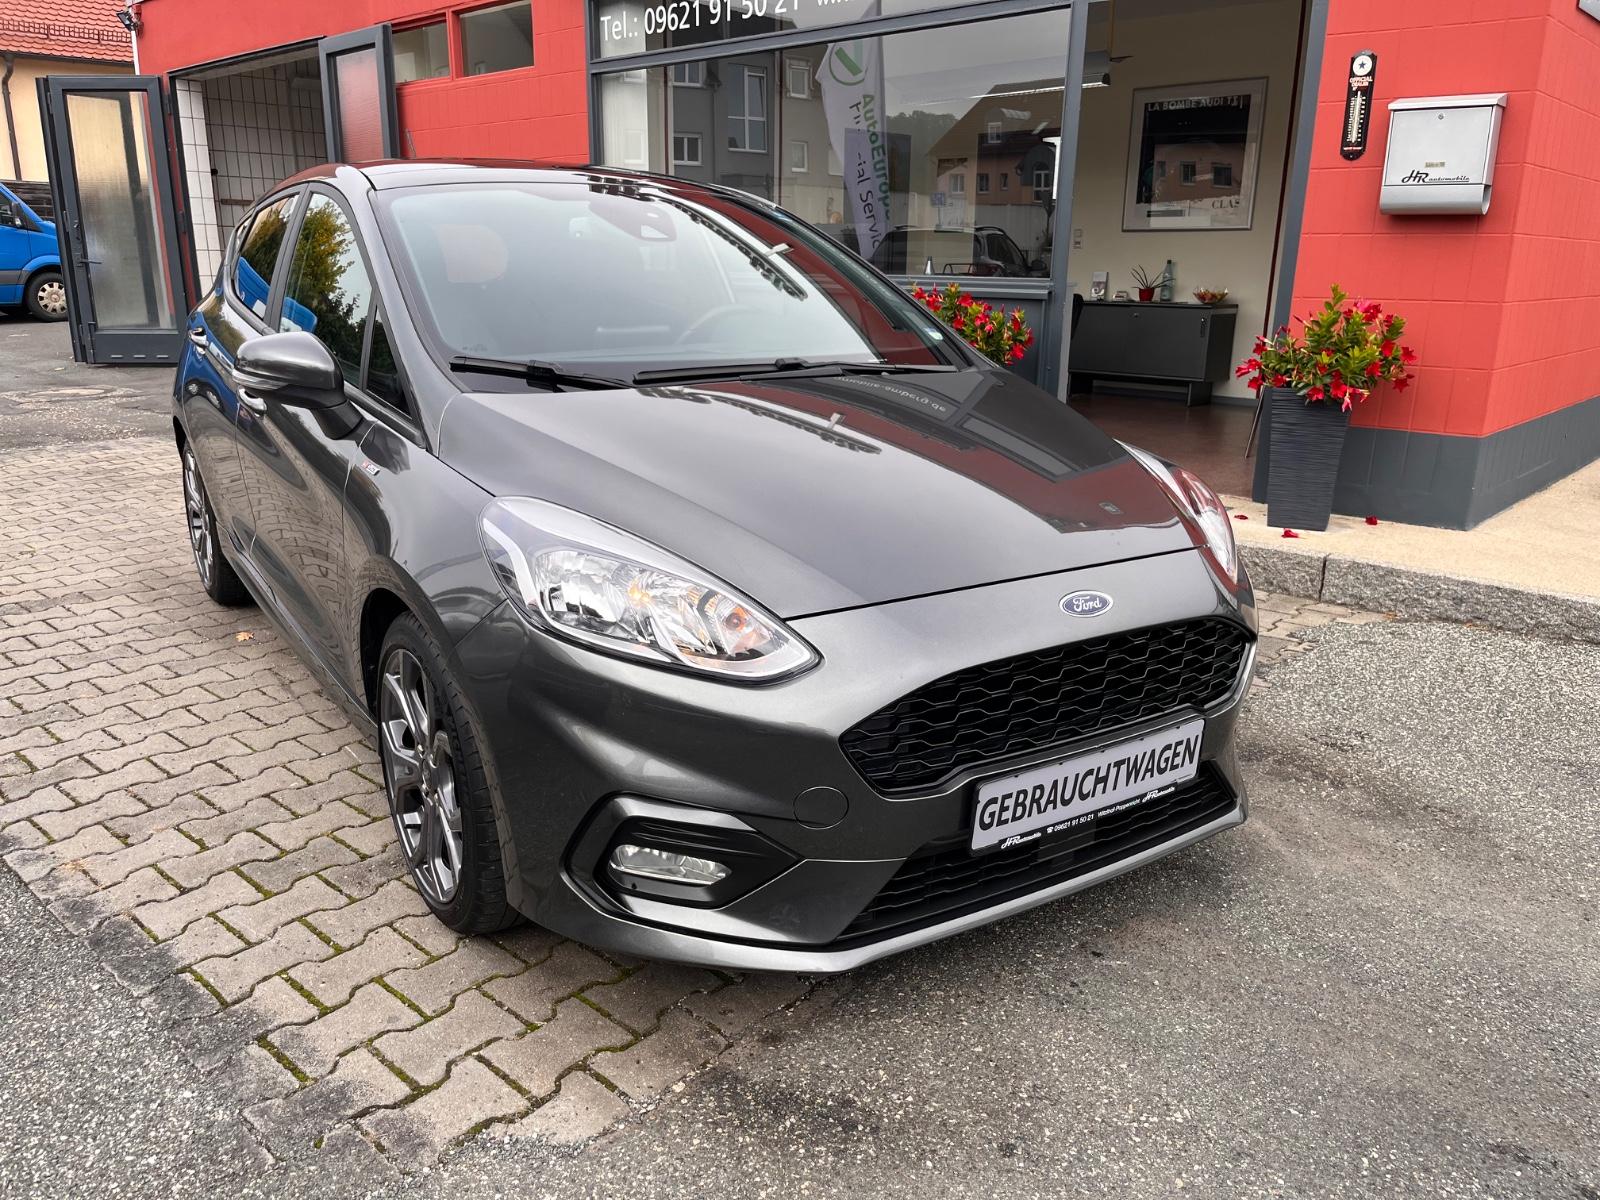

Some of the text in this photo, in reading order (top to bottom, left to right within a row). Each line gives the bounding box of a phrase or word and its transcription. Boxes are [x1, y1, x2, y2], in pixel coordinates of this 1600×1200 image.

[600, 10, 638, 41] Tel.:
[644, 0, 700, 35] 09621
[709, 0, 731, 25] 91
[1162, 99, 1198, 110] BOMBE
[1199, 96, 1224, 107] AUDI
[1072, 595, 1102, 612] Ford
[978, 734, 1199, 831] GEBRAUCHTWAGEN
